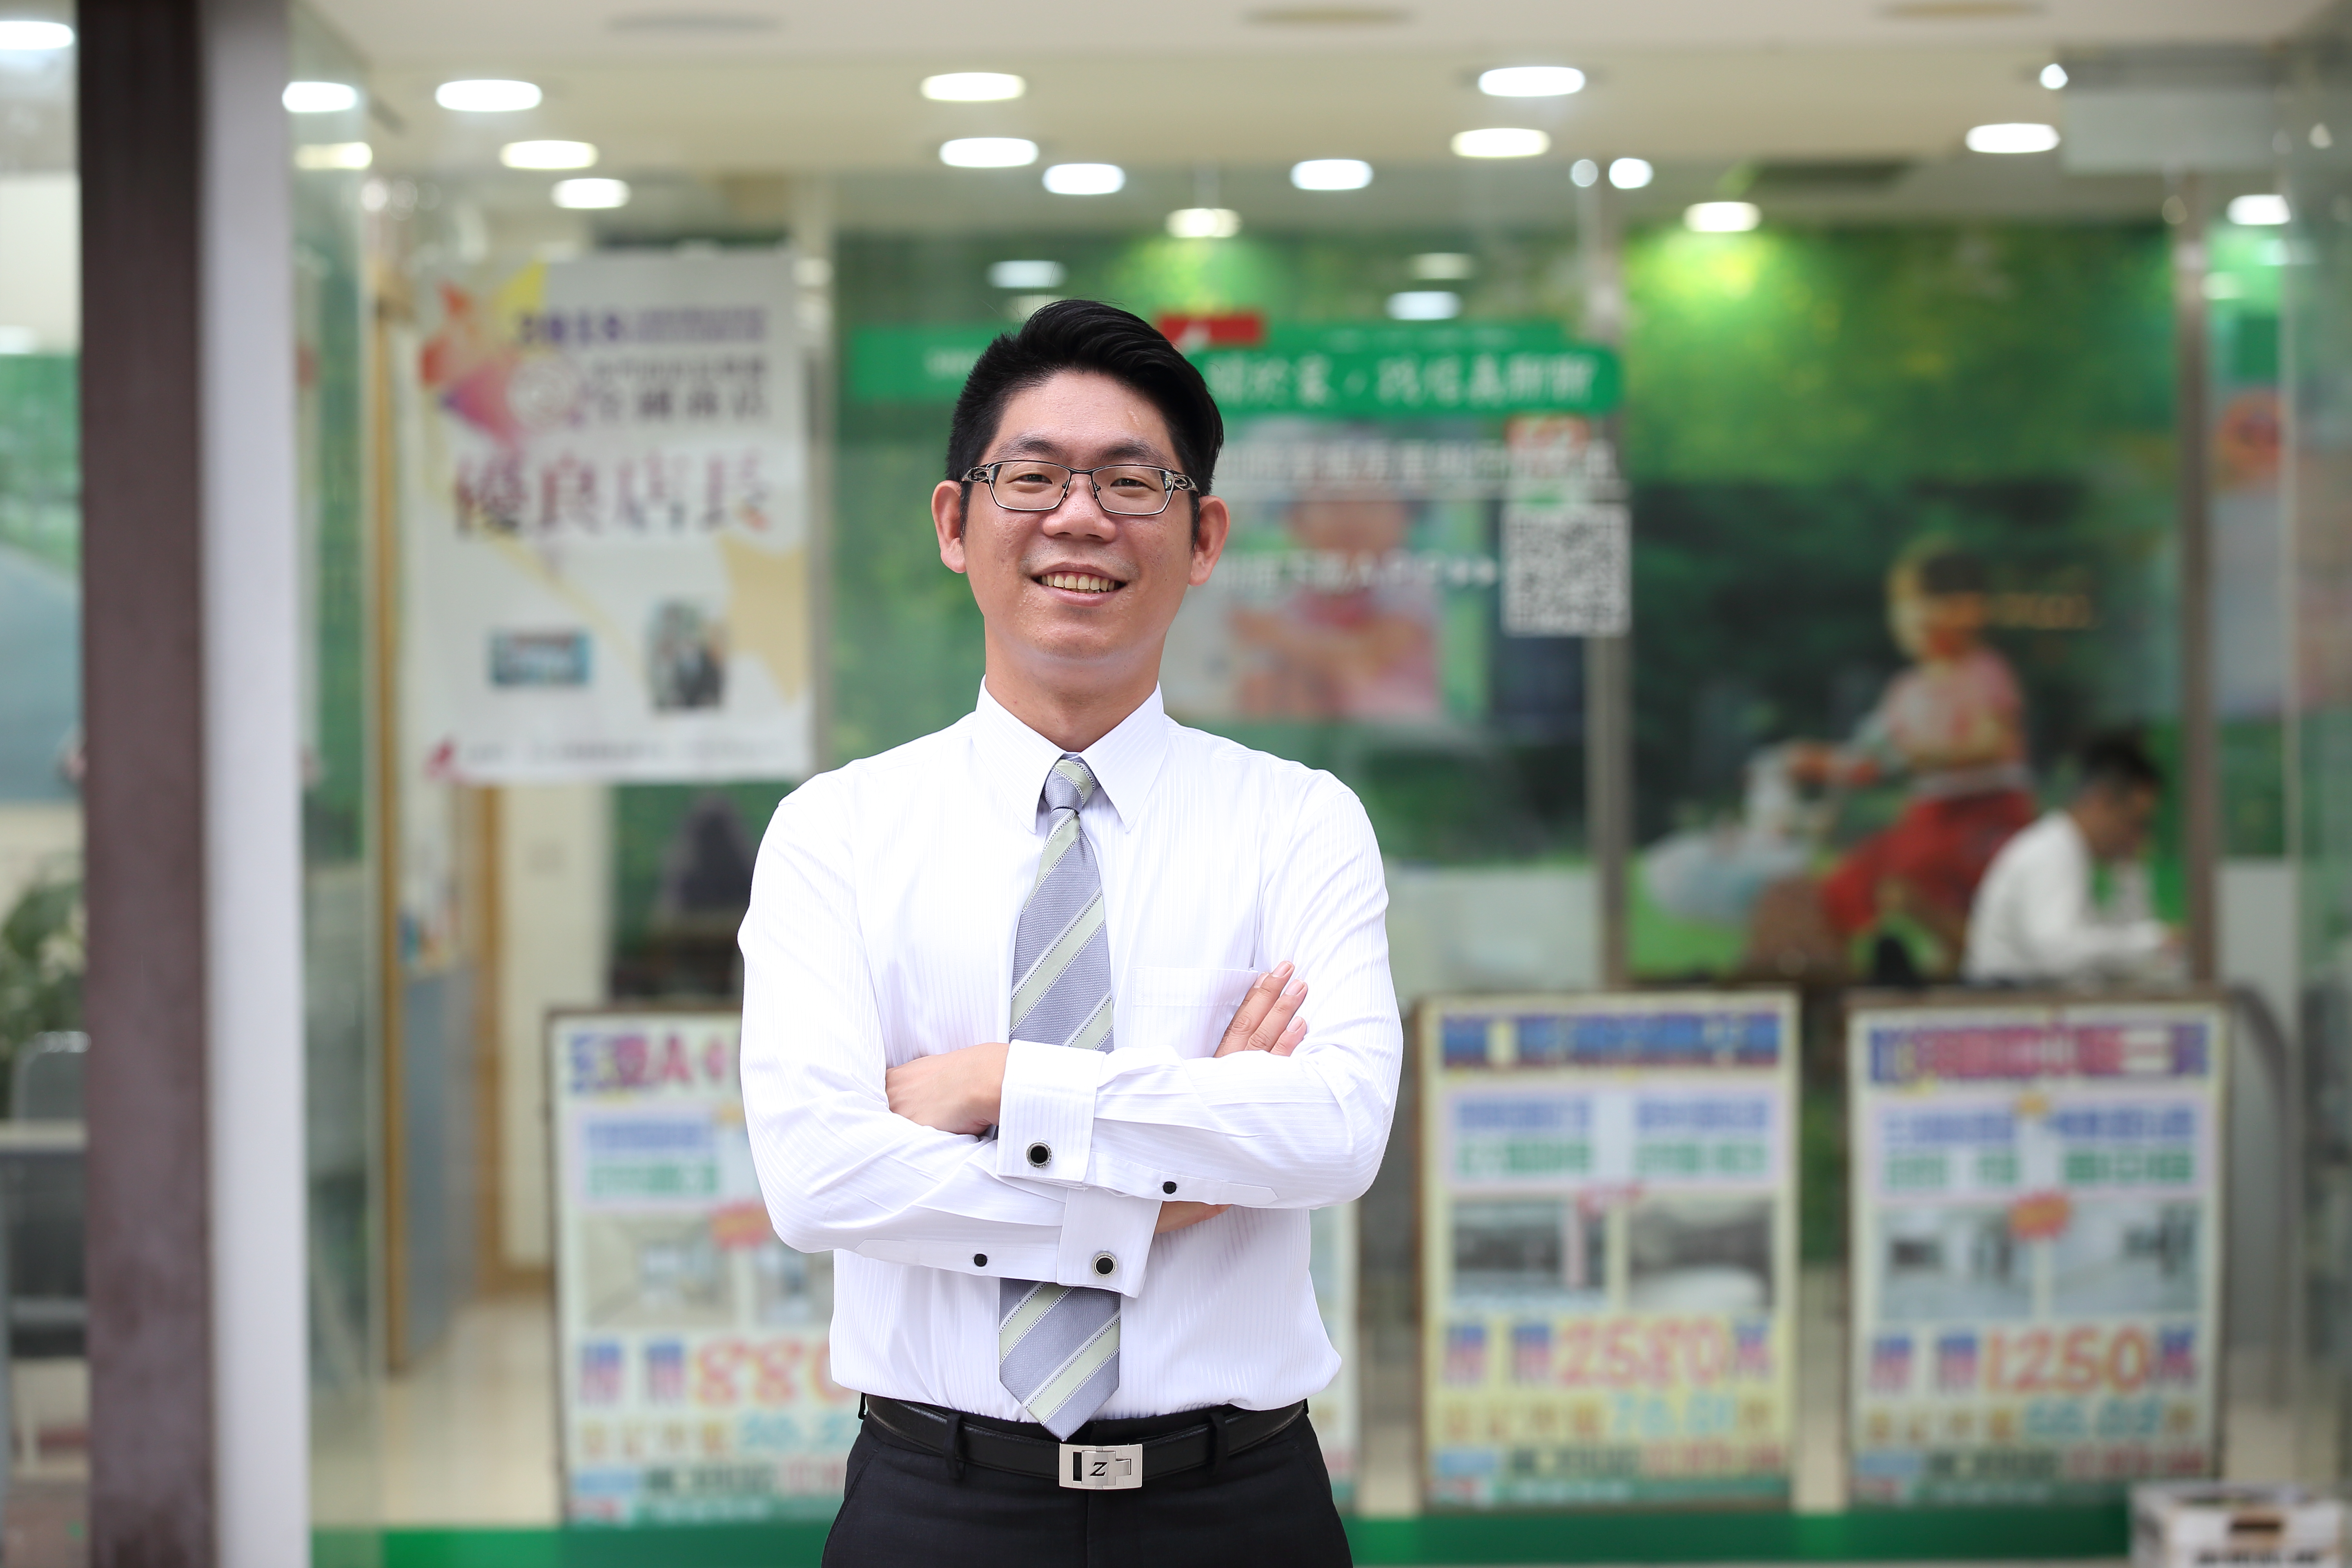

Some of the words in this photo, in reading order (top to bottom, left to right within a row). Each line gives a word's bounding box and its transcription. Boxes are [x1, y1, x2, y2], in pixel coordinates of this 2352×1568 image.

[456, 452, 771, 535] 優良店長
[1090, 1462, 1107, 1476] Z
